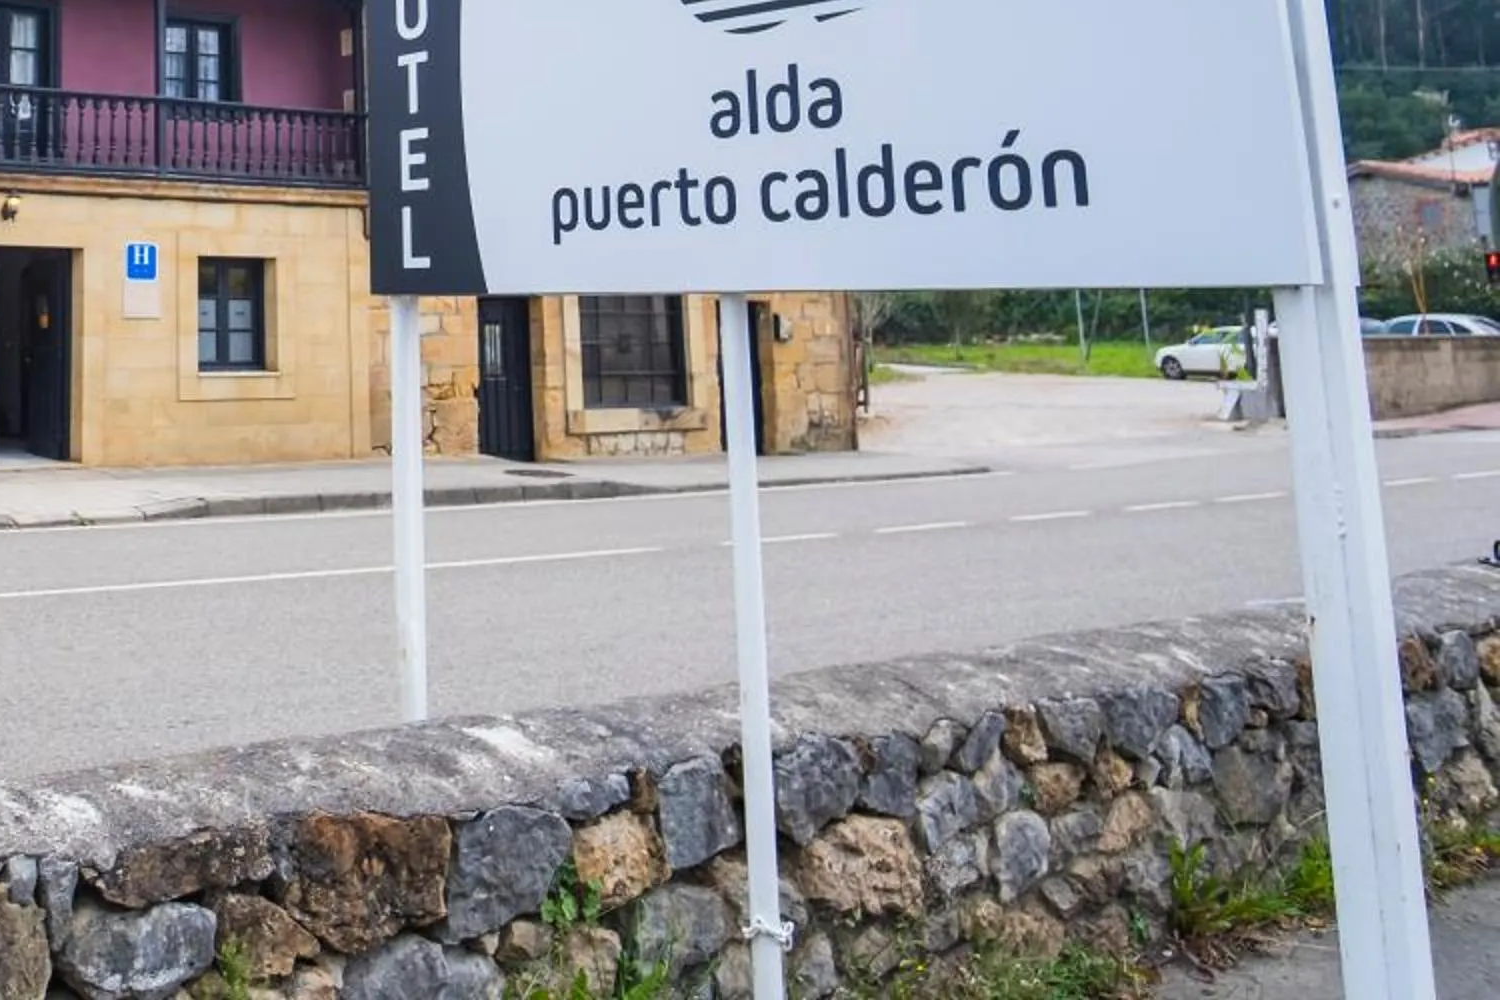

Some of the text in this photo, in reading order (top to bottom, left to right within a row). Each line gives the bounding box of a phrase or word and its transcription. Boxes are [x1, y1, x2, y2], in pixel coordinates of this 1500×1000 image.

[709, 63, 843, 140] alda
[551, 129, 1090, 247] puerto calderón
[133, 244, 150, 265] H
